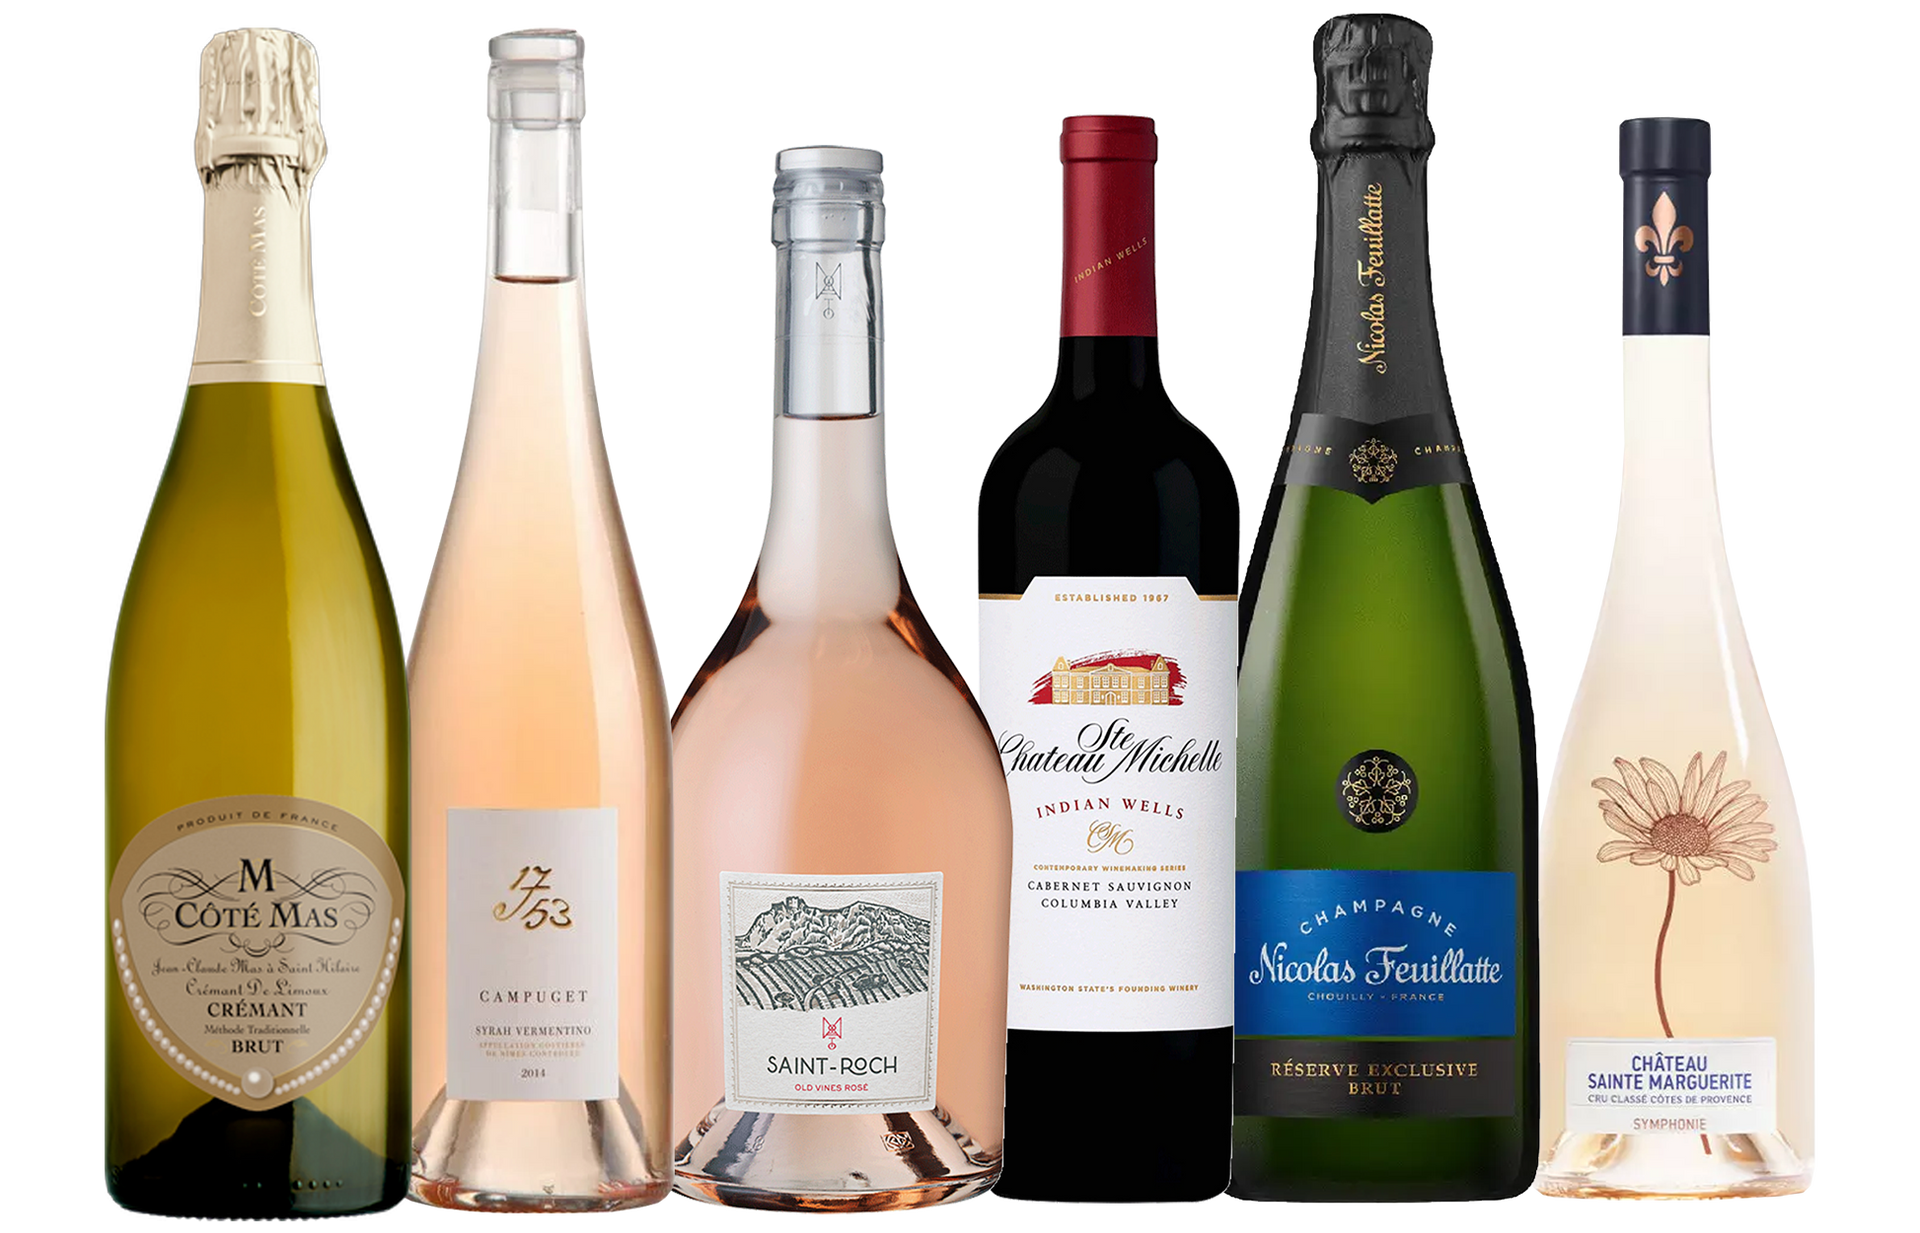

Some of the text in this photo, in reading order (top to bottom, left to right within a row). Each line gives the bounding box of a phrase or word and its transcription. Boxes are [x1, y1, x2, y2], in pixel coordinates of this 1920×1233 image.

[249, 206, 266, 253] MAS
[1074, 237, 1148, 283] INDIAN WELLS
[1357, 182, 1387, 374] Nicolas Feuillatte
[1055, 594, 1169, 602] ESTABLISHED 1967
[1077, 718, 1136, 753] Ste
[1081, 735, 1223, 785] Michelle
[1036, 797, 1184, 821] INDIAN WELLS
[176, 811, 340, 832] PRODUIT DE FRANCE
[237, 858, 275, 893] M
[1033, 864, 1186, 872] CONTEMPORARY WINEMAKING SERIES
[1027, 880, 1192, 892] CABERNET SAUVIGNON
[1041, 898, 1178, 909] COLUMBIA VALLEY
[175, 901, 338, 928] CÔTÉ MAS
[1300, 899, 1457, 937] CHAMPAGNE
[230, 957, 262, 974] Mas
[266, 962, 274, 974] à
[278, 957, 313, 974] Saint
[1249, 942, 1503, 985] Nicolas Feuillatte
[186, 977, 329, 996] Crémant De Limoux
[1019, 983, 1075, 993] WASHINGTON
[1118, 985, 1166, 993] FOUNDING
[1168, 984, 1199, 992] WINERY
[479, 989, 589, 1003] CAMPUGET
[1307, 992, 1445, 1001] CHOUILLY FRANCE
[207, 999, 308, 1018] CRÉMANT
[204, 1024, 311, 1035] Méthode Traditionnelle
[475, 1025, 592, 1037] SYRAH VERMENTINO
[231, 1039, 285, 1054] BRUT
[1270, 1058, 1478, 1077] RÉSERVE EXCLUSIVE
[1631, 1052, 1708, 1072] CHÂTEAU
[520, 1068, 546, 1079] 2014
[1587, 1073, 1752, 1090] SAINTE MARGUERITE
[794, 1083, 869, 1092] OLD VINES ROSÉ
[1348, 1082, 1402, 1095] BRUT
[1588, 1093, 1752, 1104] CRU CLASSÉ CÔTES DE PROVENCE
[1633, 1118, 1707, 1130] SYMPHONIE
